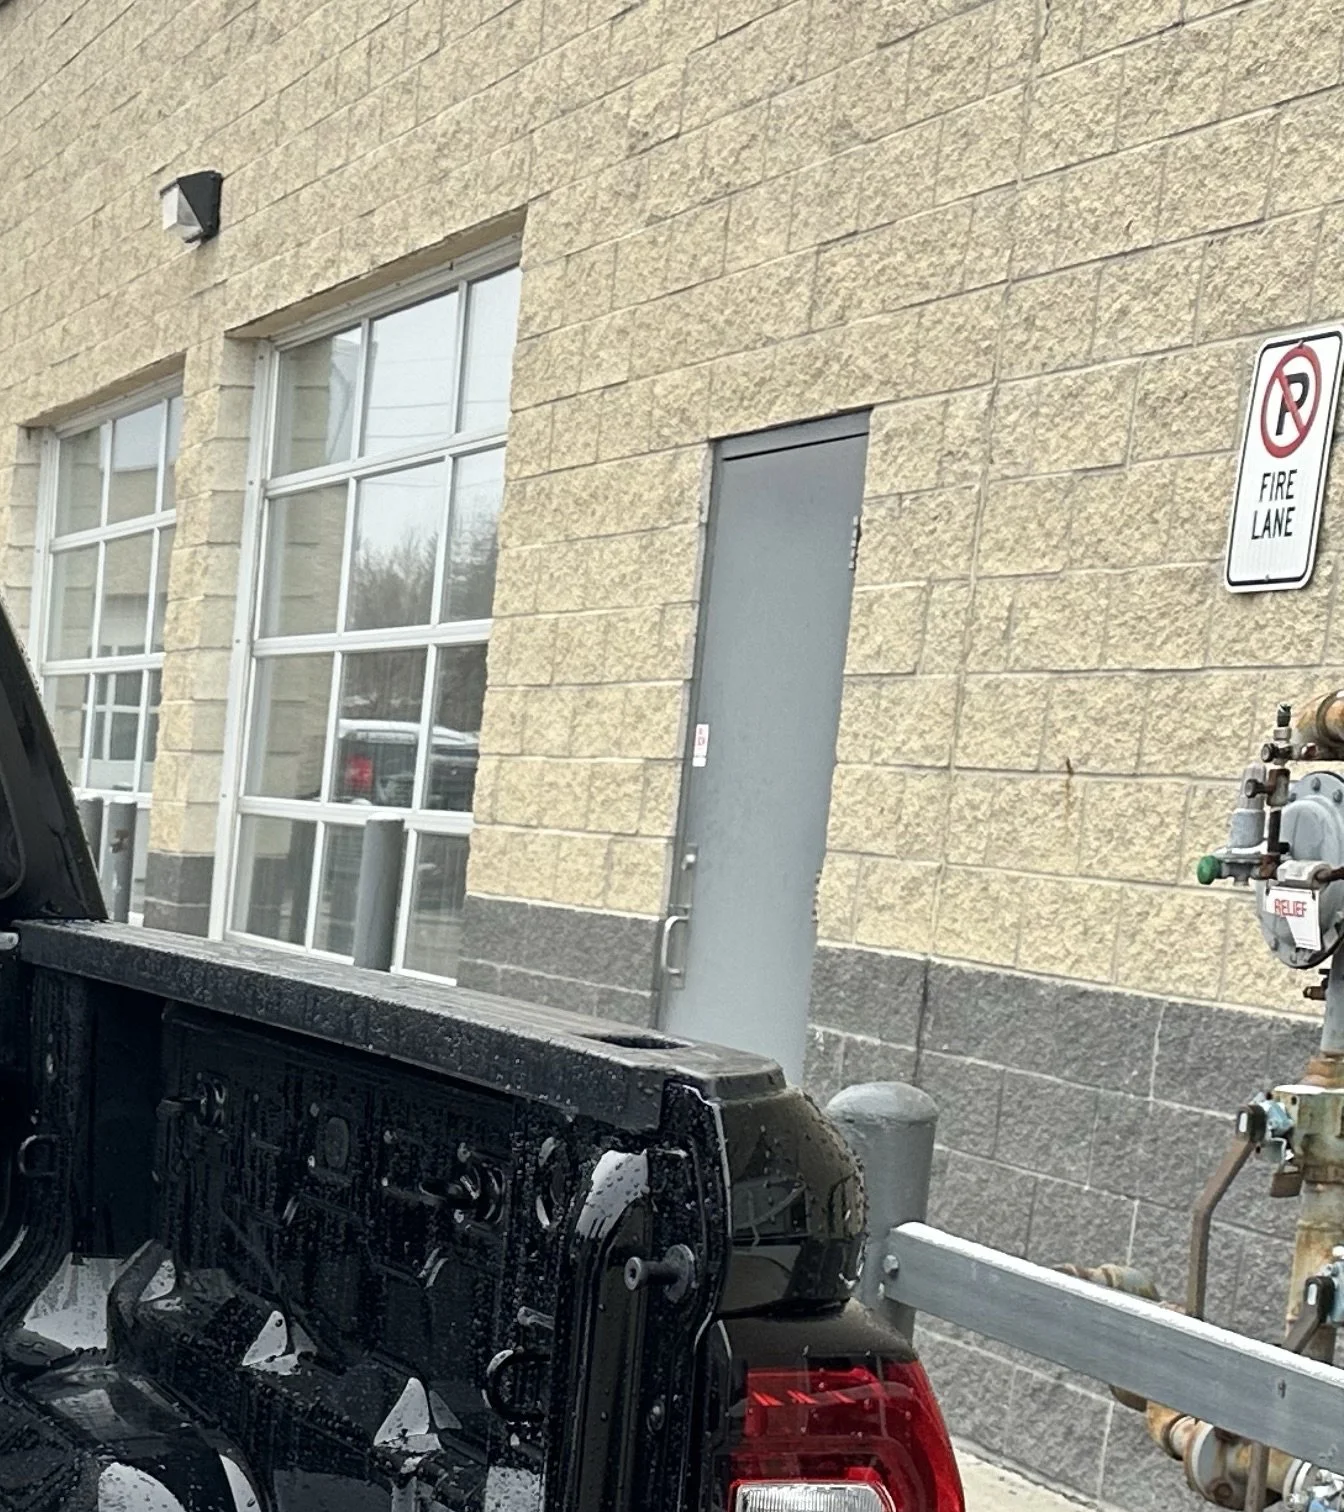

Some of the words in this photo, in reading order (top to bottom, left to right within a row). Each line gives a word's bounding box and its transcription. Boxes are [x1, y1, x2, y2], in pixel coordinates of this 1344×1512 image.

[1258, 468, 1298, 503] FIRE
[1250, 506, 1296, 540] LANE
[1274, 898, 1308, 918] RELIEF
